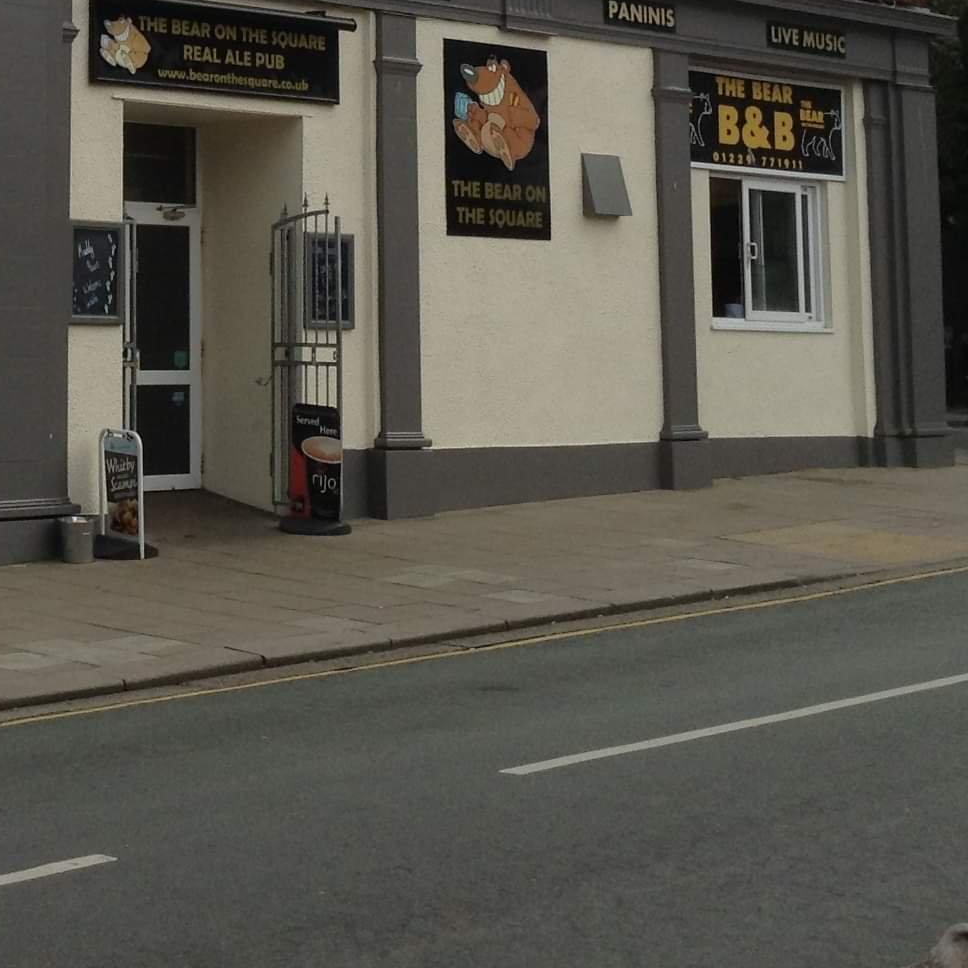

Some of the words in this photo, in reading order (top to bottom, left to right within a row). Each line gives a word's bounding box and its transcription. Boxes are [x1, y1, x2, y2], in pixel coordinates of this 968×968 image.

[608, 0, 676, 29] PANINIS
[138, 14, 167, 33] THE
[171, 18, 211, 39] BEAR
[215, 23, 237, 41] ON
[241, 26, 268, 45] THE
[272, 30, 326, 51] SQUARE
[770, 25, 800, 48] LIVE
[803, 30, 846, 53] MUSIC
[183, 44, 221, 64] REAL
[225, 48, 252, 67] ALE
[256, 51, 285, 70] PUB
[715, 76, 745, 98] THE
[752, 81, 793, 104] BEAR
[718, 104, 795, 151] B&B
[800, 109, 825, 123] BEAR
[451, 179, 481, 199] THE
[484, 181, 522, 202] BEAR
[525, 185, 547, 203] ON
[456, 206, 485, 225] THE
[488, 208, 543, 229] SQUARE
[296, 415, 320, 426] Served
[106, 457, 136, 473] Whitby
